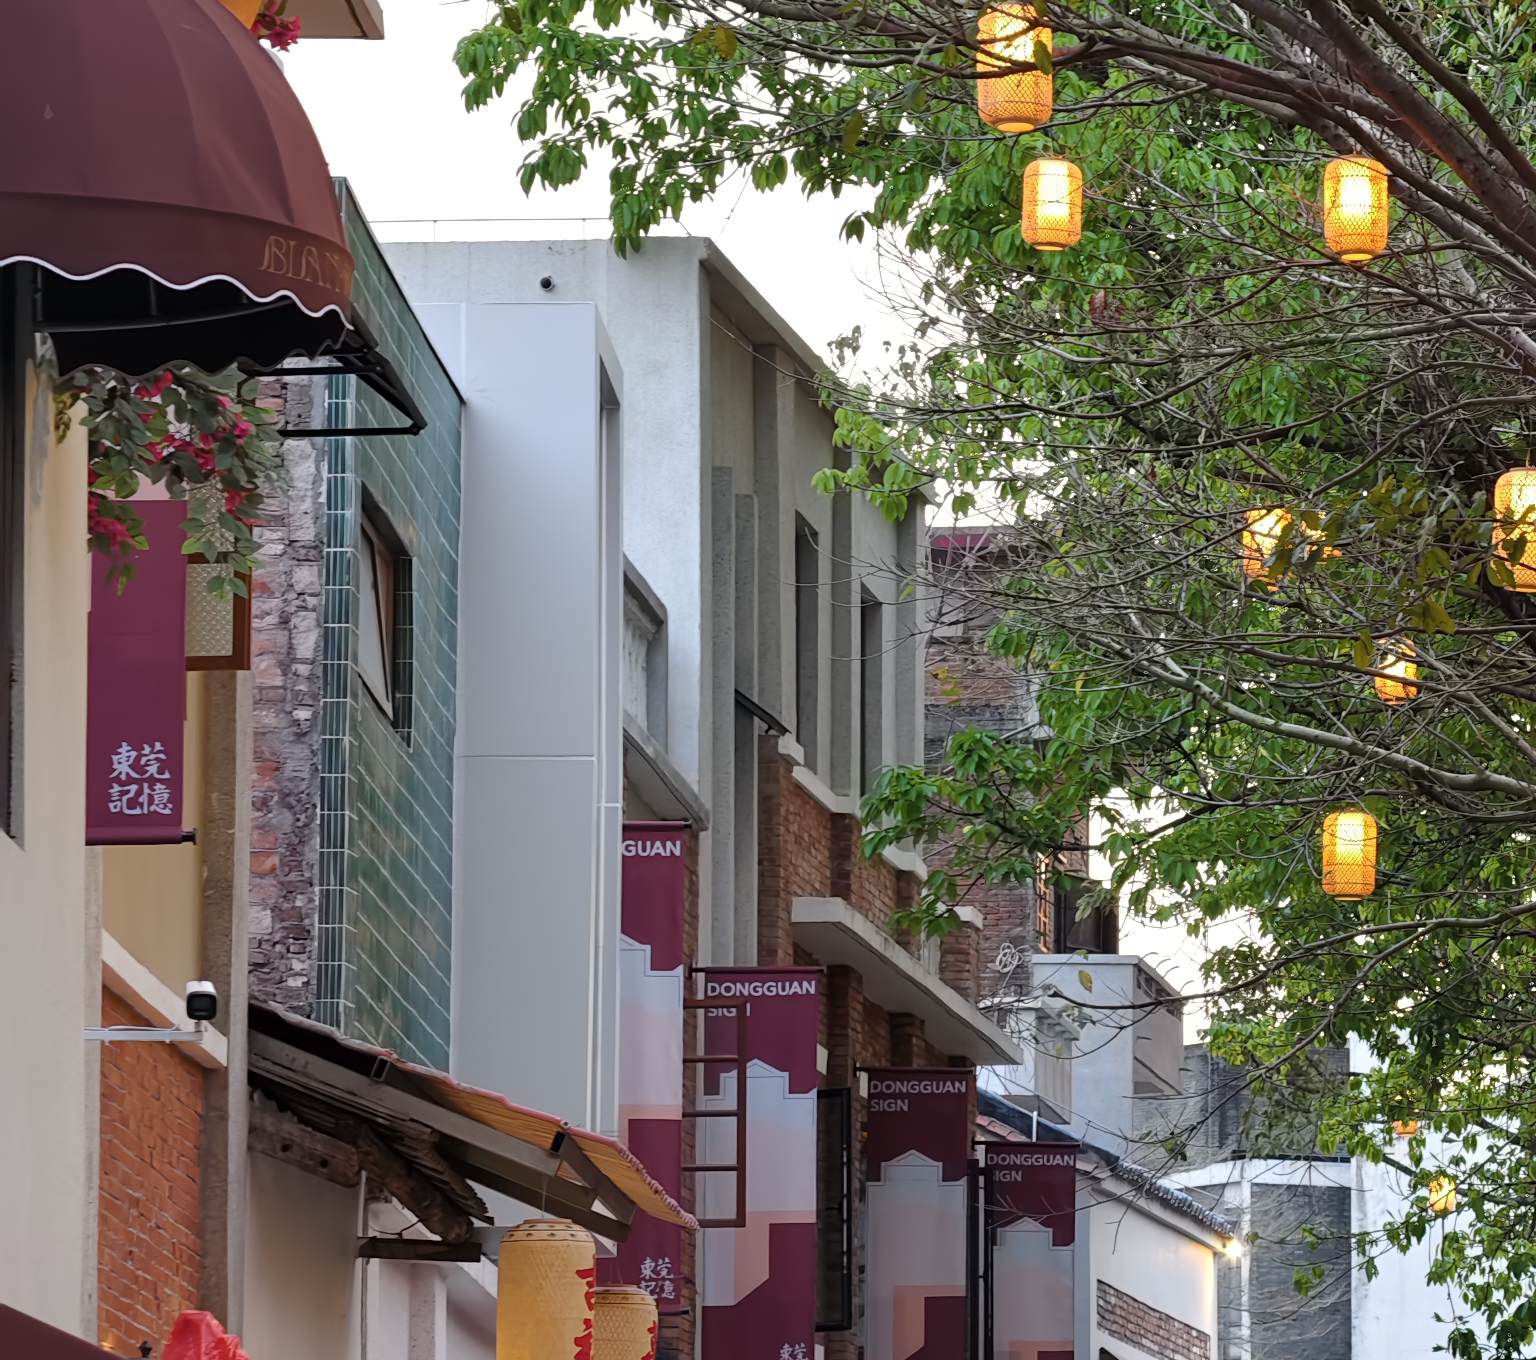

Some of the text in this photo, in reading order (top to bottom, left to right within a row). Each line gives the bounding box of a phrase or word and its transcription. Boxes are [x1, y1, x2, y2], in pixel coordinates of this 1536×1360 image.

[108, 741, 171, 780] 東莞
[107, 782, 173, 815] 記憶
[706, 980, 816, 997] DONGGUAN
[869, 1080, 967, 1095] DONGGUAN
[869, 1098, 909, 1112] SIGN
[987, 1153, 1075, 1168] DONGGUAN
[991, 1170, 1023, 1183] IGN
[640, 1256, 675, 1280] 東莞
